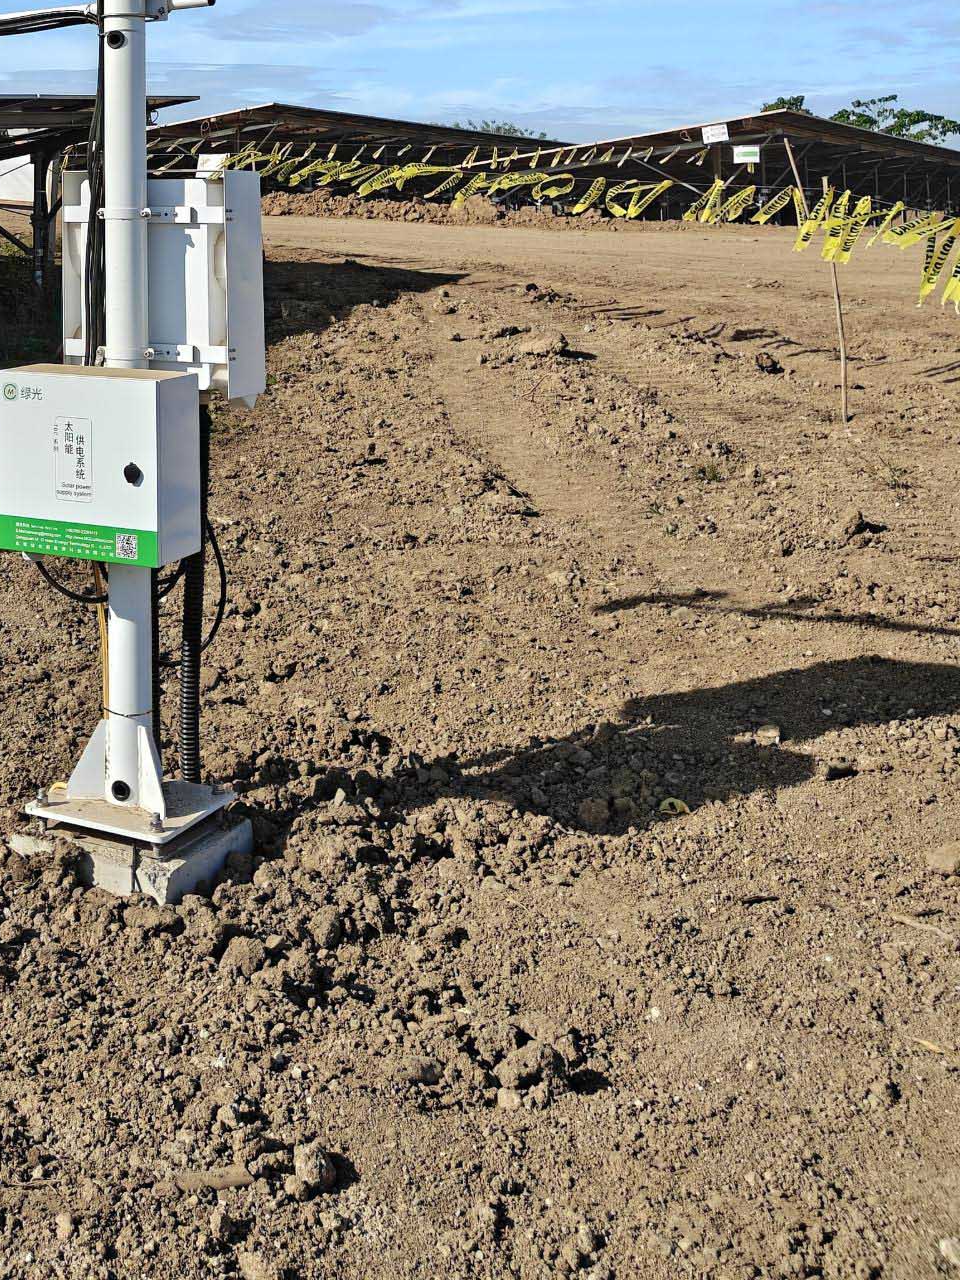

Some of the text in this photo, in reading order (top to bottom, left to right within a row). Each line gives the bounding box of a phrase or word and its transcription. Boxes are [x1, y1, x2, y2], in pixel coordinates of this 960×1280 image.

[20, 386, 43, 401] 绿光
[64, 420, 74, 455] 太阳能
[75, 434, 86, 480] 供电系统
